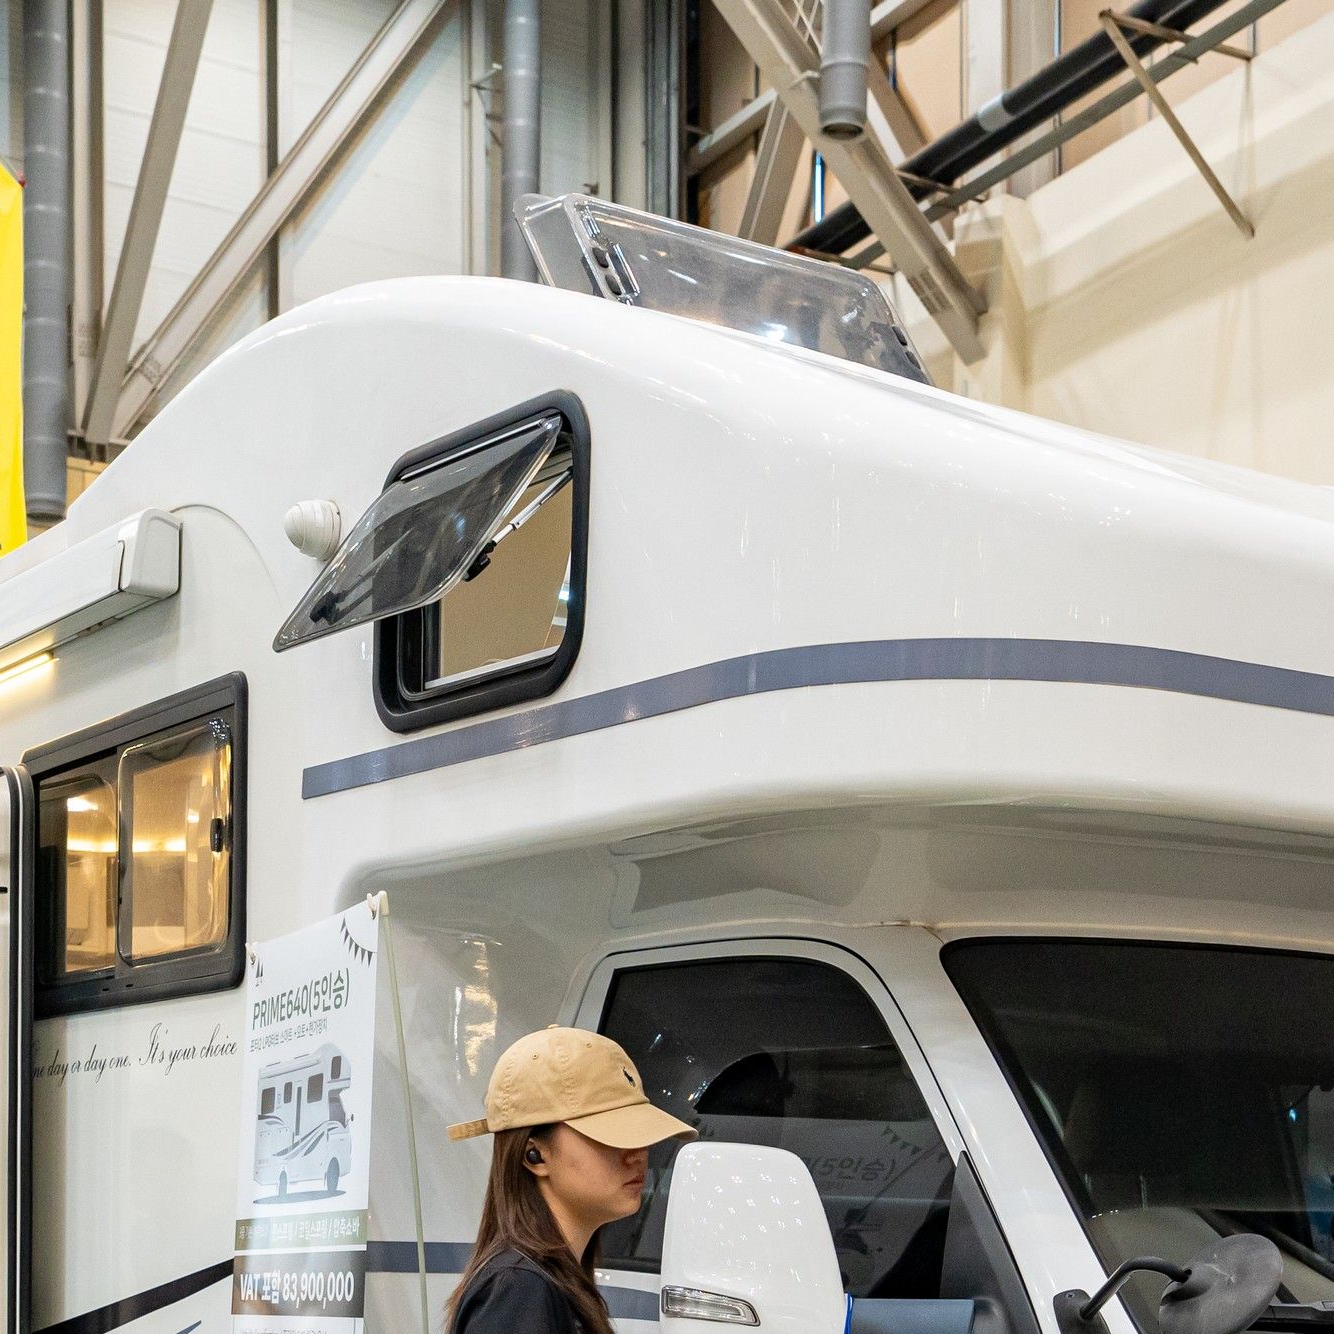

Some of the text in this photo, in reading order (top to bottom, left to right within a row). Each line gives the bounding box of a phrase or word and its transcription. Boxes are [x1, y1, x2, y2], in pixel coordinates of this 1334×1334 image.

[253, 968, 349, 1030] PRIME640(5인승)
[47, 1049, 68, 1087] day
[70, 1060, 81, 1074] or
[84, 1044, 107, 1087] day
[139, 1022, 168, 1066] It's
[165, 1045, 196, 1076] your
[200, 1023, 237, 1058] choice
[239, 1271, 355, 1310] VAT 포함 83,900,000
